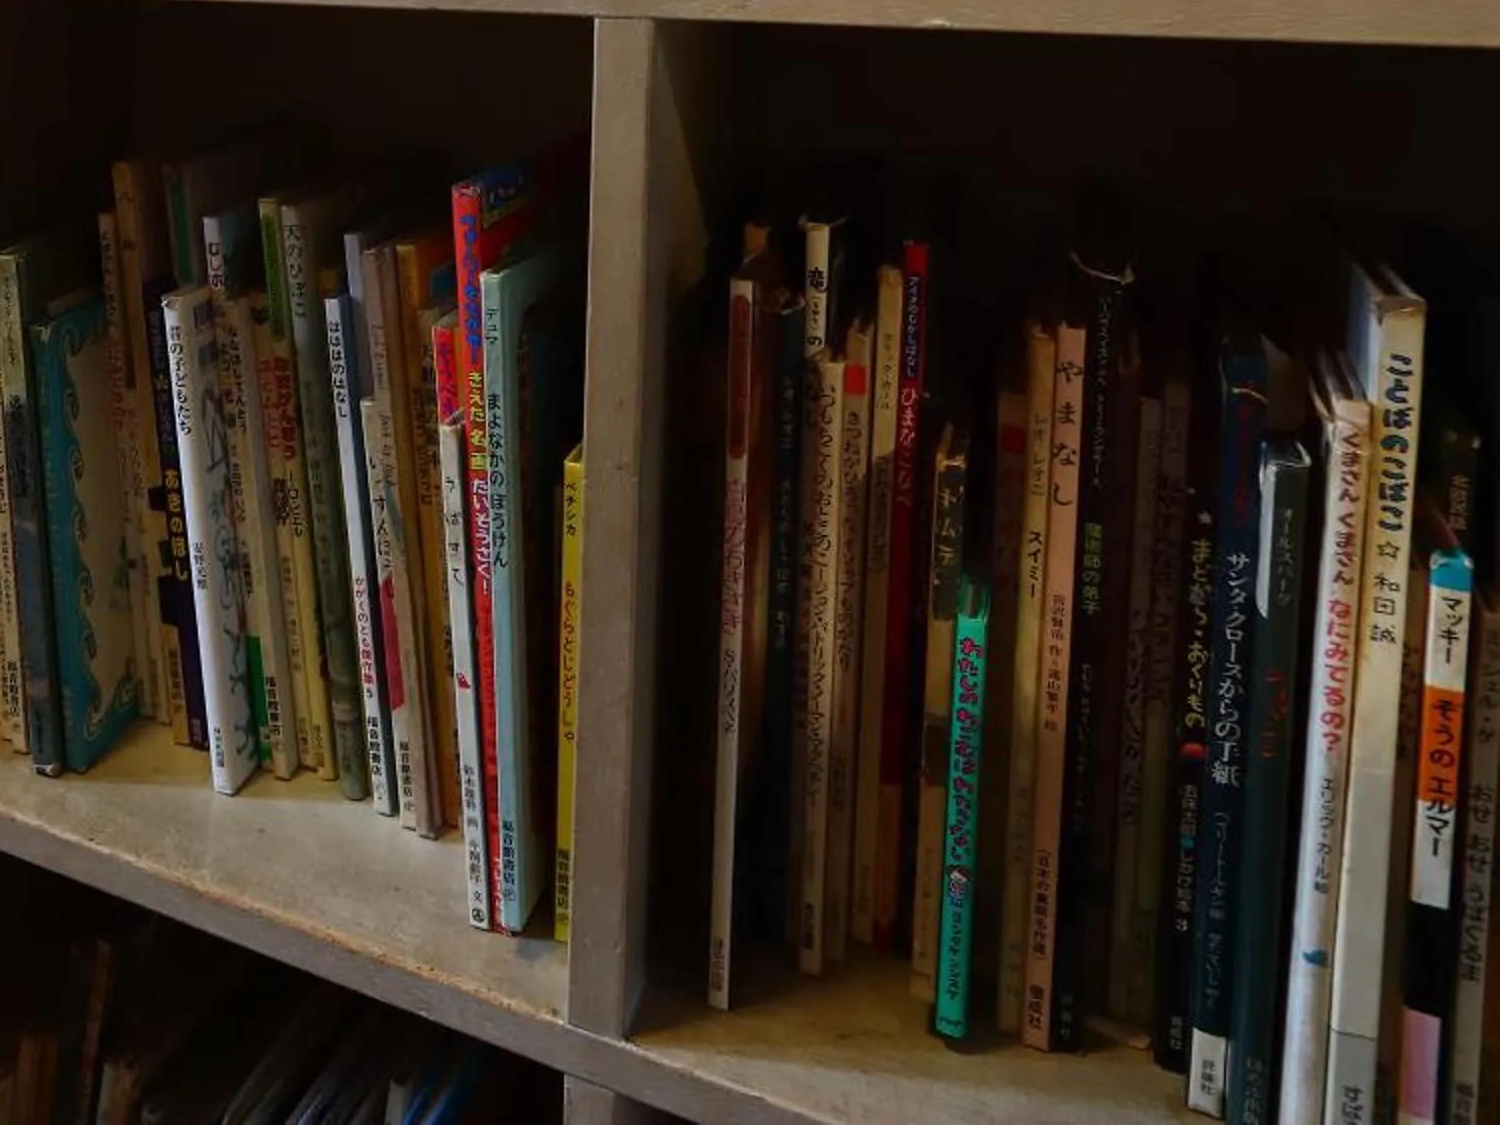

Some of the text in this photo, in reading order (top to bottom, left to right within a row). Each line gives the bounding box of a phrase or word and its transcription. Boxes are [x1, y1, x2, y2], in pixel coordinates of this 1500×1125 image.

[329, 321, 348, 419] はははのはなし
[1053, 360, 1084, 508] やまなし
[164, 468, 190, 582] あきのほし
[1369, 353, 1413, 645] ことばのこばこ 和田誠
[1026, 529, 1044, 599] スイミー
[354, 577, 376, 686] かがくのとも傑作集
[1438, 596, 1464, 665] マッキー
[1426, 698, 1461, 858] ぞうのエルマー
